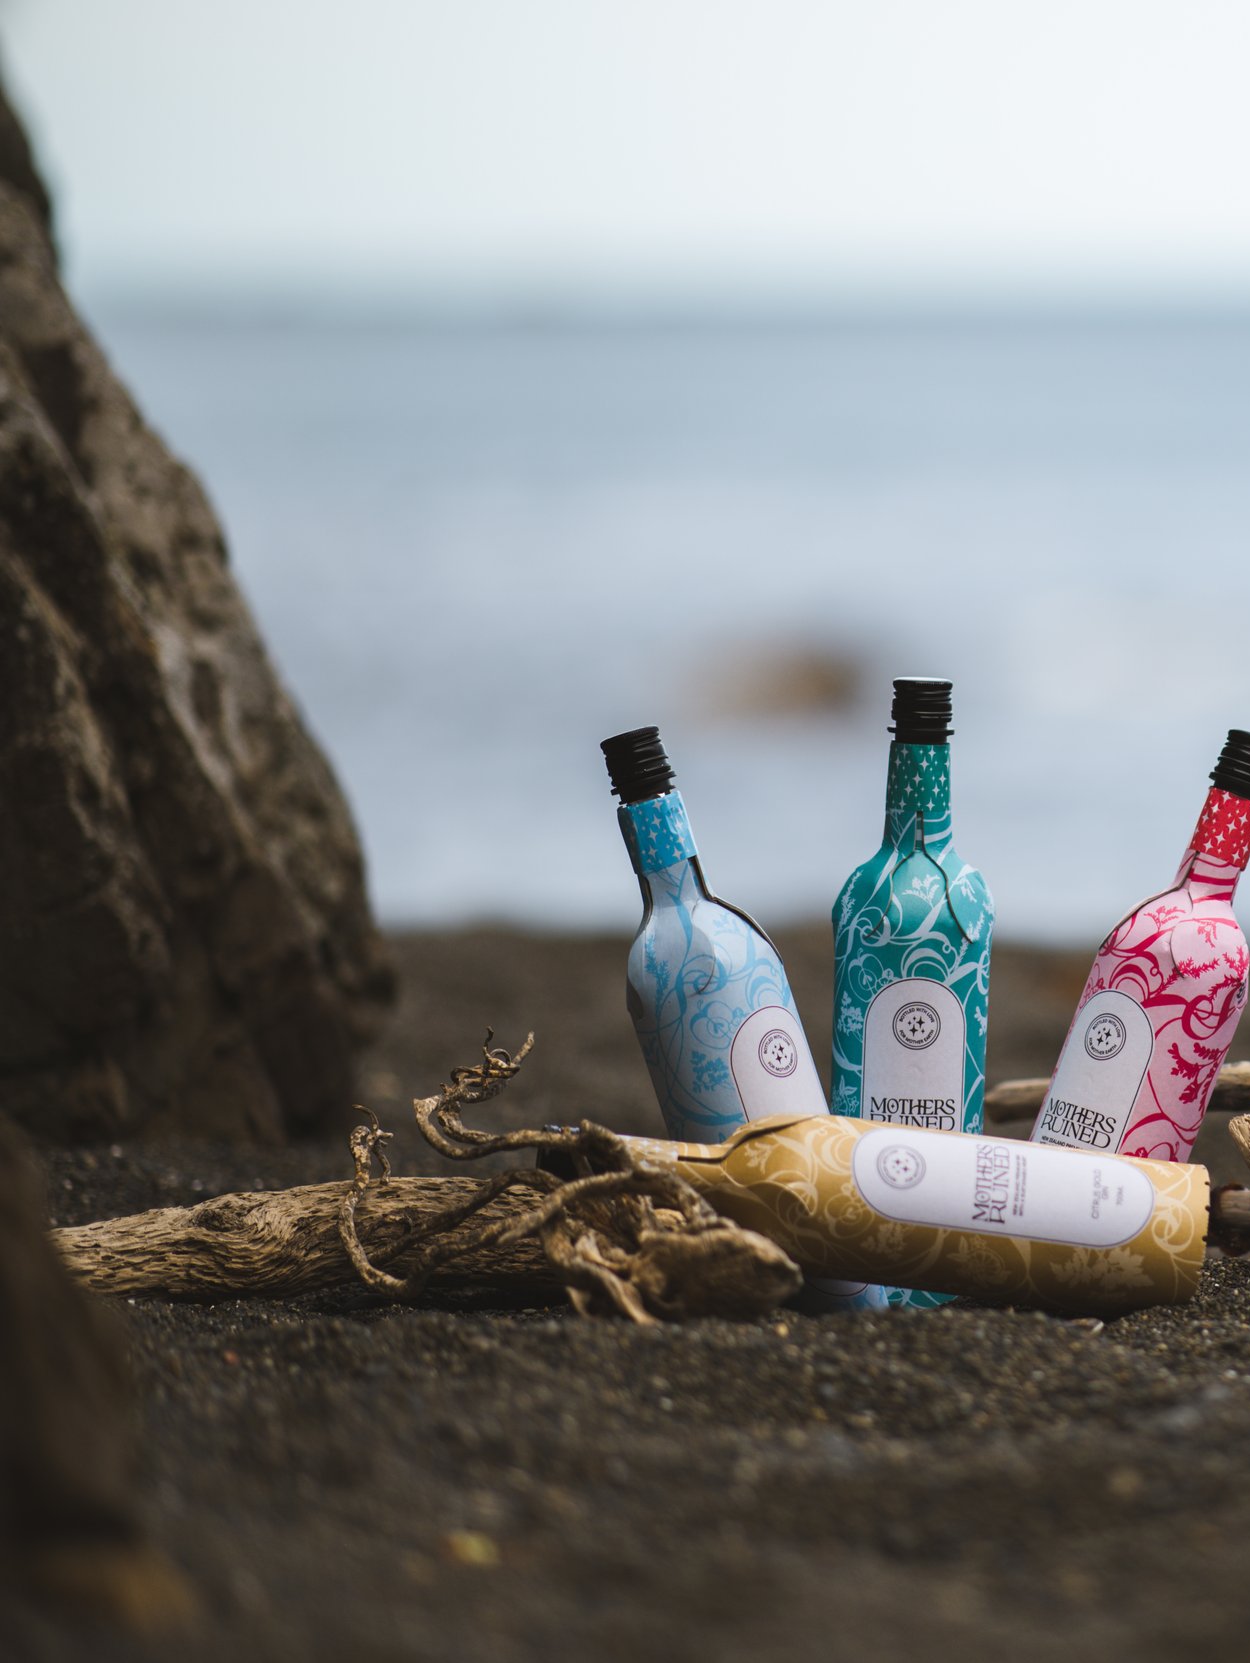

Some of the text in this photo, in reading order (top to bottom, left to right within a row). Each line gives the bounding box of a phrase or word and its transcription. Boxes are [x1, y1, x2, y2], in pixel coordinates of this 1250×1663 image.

[898, 1007, 935, 1024] BOTTLED WITH LOVE
[1092, 1018, 1108, 1031] BOTTLED
[905, 1036, 925, 1045] MOTHER
[923, 1029, 935, 1043] EARTH
[1090, 1045, 1105, 1056] MOTHER
[1104, 1043, 1118, 1055] EARTH
[870, 1096, 956, 1116] MOTHERS
[1046, 1097, 1117, 1134] MOTHERS
[1040, 1113, 1111, 1149] RUINED
[972, 1143, 993, 1223] MOTHERS
[988, 1145, 1010, 1225] RUINED
